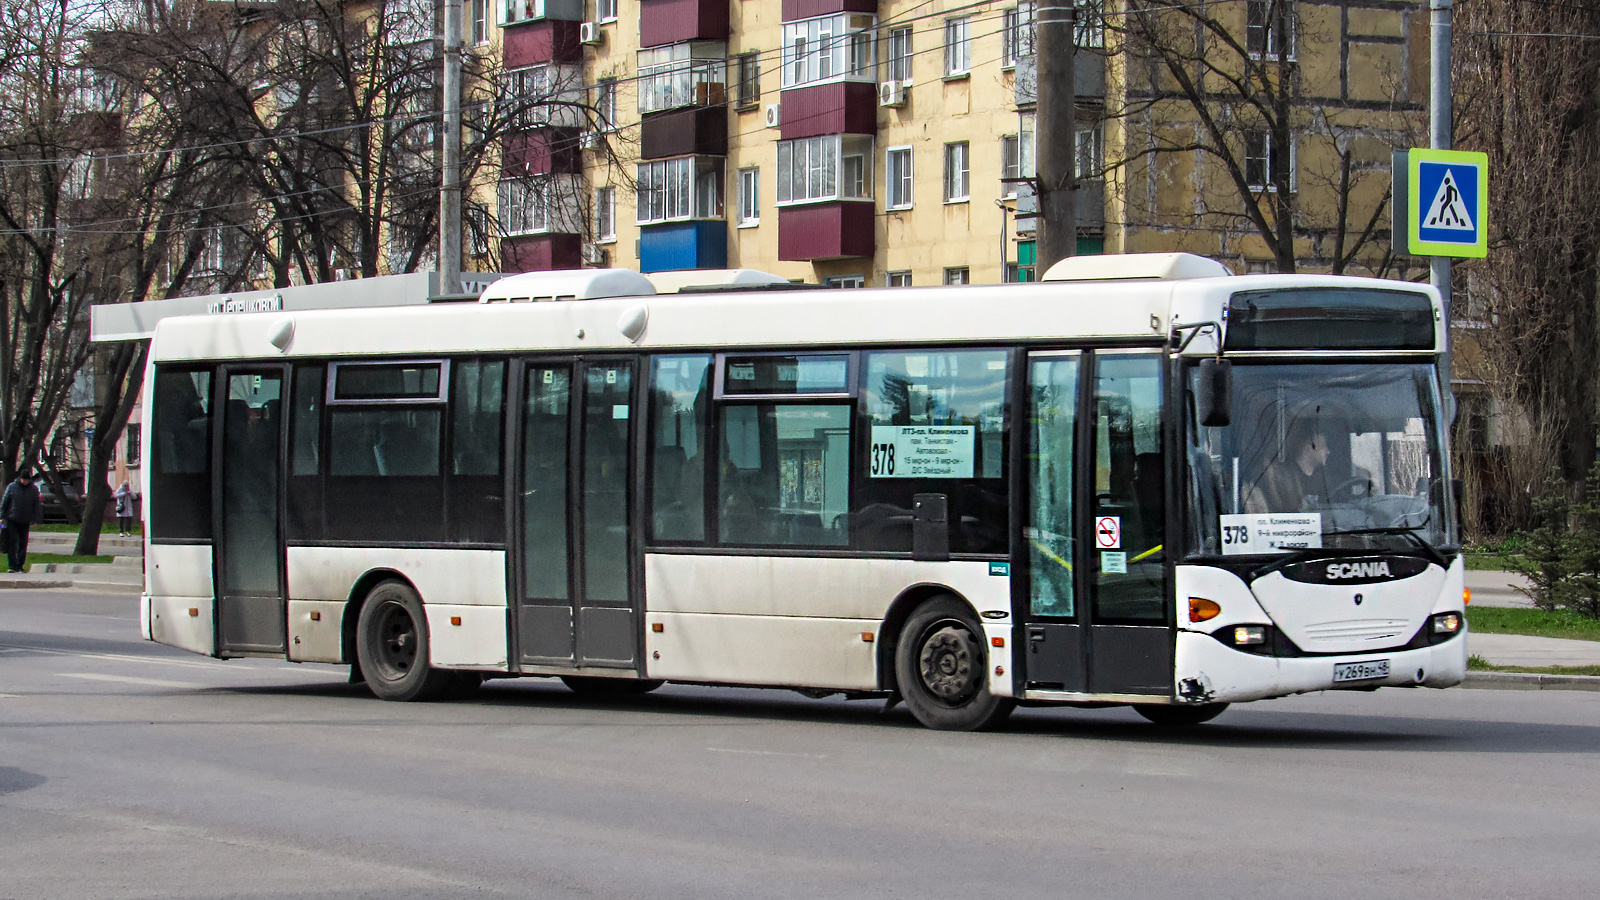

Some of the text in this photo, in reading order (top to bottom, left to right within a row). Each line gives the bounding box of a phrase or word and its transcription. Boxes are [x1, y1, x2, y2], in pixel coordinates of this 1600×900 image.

[872, 443, 895, 475] 378
[1223, 525, 1249, 544] 378
[1326, 561, 1391, 579] SCANIA
